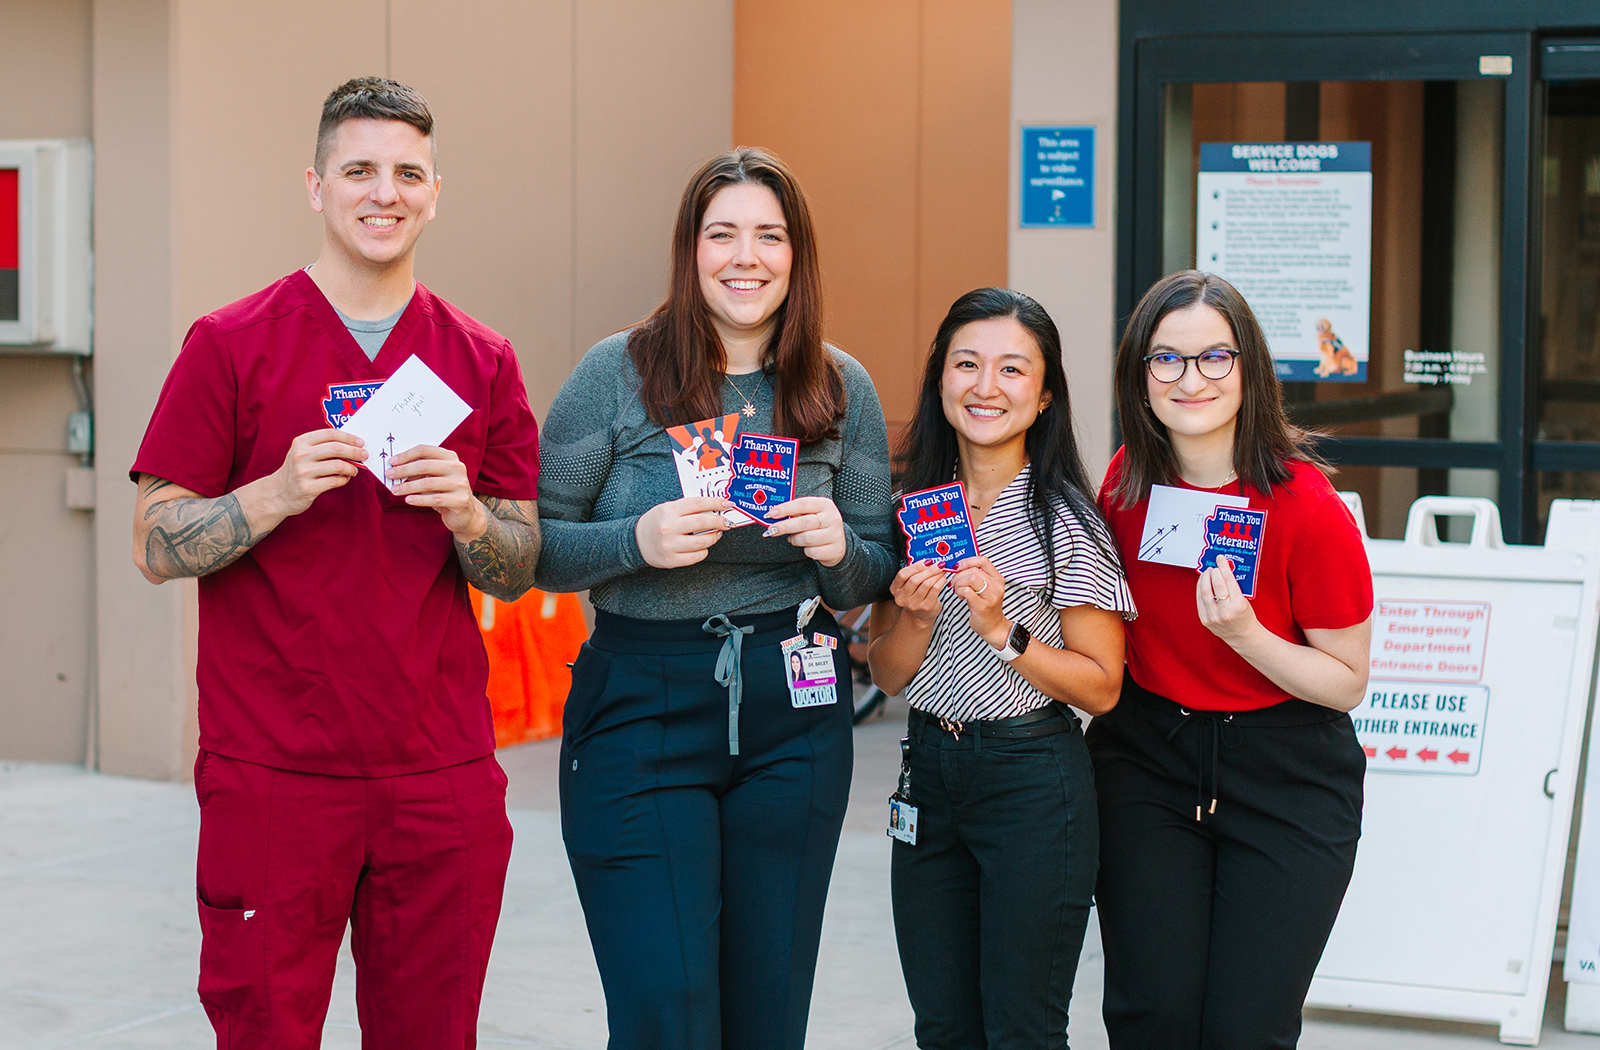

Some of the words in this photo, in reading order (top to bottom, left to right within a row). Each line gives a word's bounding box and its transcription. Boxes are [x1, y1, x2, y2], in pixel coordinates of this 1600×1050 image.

[1038, 137, 1058, 147] This
[1047, 150, 1080, 161] subject
[1232, 145, 1294, 158] SERVICE
[1296, 145, 1339, 158] DOGS
[1051, 164, 1077, 173] video
[1248, 159, 1321, 171] WELCOME
[1404, 349, 1452, 361] Business
[1452, 350, 1485, 363] Hours
[1403, 372, 1439, 385] Monday
[1444, 373, 1472, 386] Friday
[334, 388, 367, 399] Thank
[391, 391, 416, 413] Thank
[744, 440, 773, 452] Thank
[775, 443, 792, 454] You
[735, 462, 790, 480] Veterans!
[745, 483, 777, 493] CELEBRATING
[739, 499, 767, 511] VETERANS
[770, 494, 785, 502] 2025
[908, 494, 941, 509] Thank
[940, 491, 959, 501] You
[907, 511, 965, 534] Veterans!
[1219, 511, 1245, 523] Thank
[1246, 514, 1261, 525] You
[925, 534, 957, 547] CELEBRATING
[953, 539, 968, 548] 2025
[1209, 533, 1258, 550] Veterans!
[954, 548, 966, 558] DAY
[1379, 605, 1418, 616] Enter
[1424, 607, 1485, 622] Through
[1388, 623, 1471, 638] Emergency
[814, 633, 836, 648] SHE/HER
[1384, 640, 1471, 655] Department
[1371, 659, 1433, 671] Entrance
[1438, 662, 1479, 673] Doors
[794, 686, 834, 705] DOCTOR
[1370, 692, 1431, 711] PLEASE
[1436, 695, 1468, 713] USE
[1354, 718, 1399, 734] OTHER
[1404, 720, 1479, 739] ENTRANCE
[1579, 960, 1596, 971] VA
